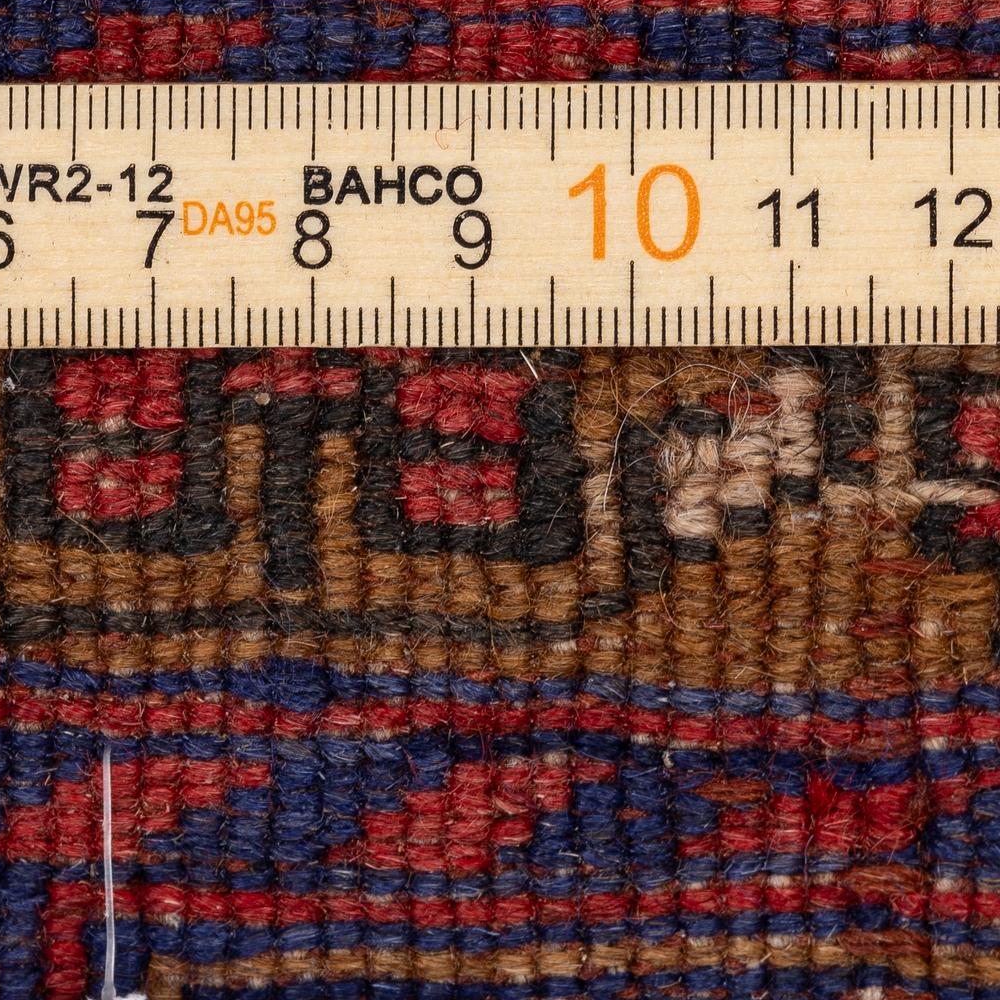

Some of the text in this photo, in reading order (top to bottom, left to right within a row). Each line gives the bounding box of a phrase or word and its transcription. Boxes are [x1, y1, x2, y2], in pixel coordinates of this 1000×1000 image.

[303, 165, 484, 206] BAHCO
[567, 162, 702, 263] 10
[135, 209, 176, 269] 7
[182, 199, 277, 237] DA95
[292, 209, 334, 270] 8
[452, 209, 493, 270] 9
[757, 188, 820, 248] 11
[914, 187, 993, 249] 12
